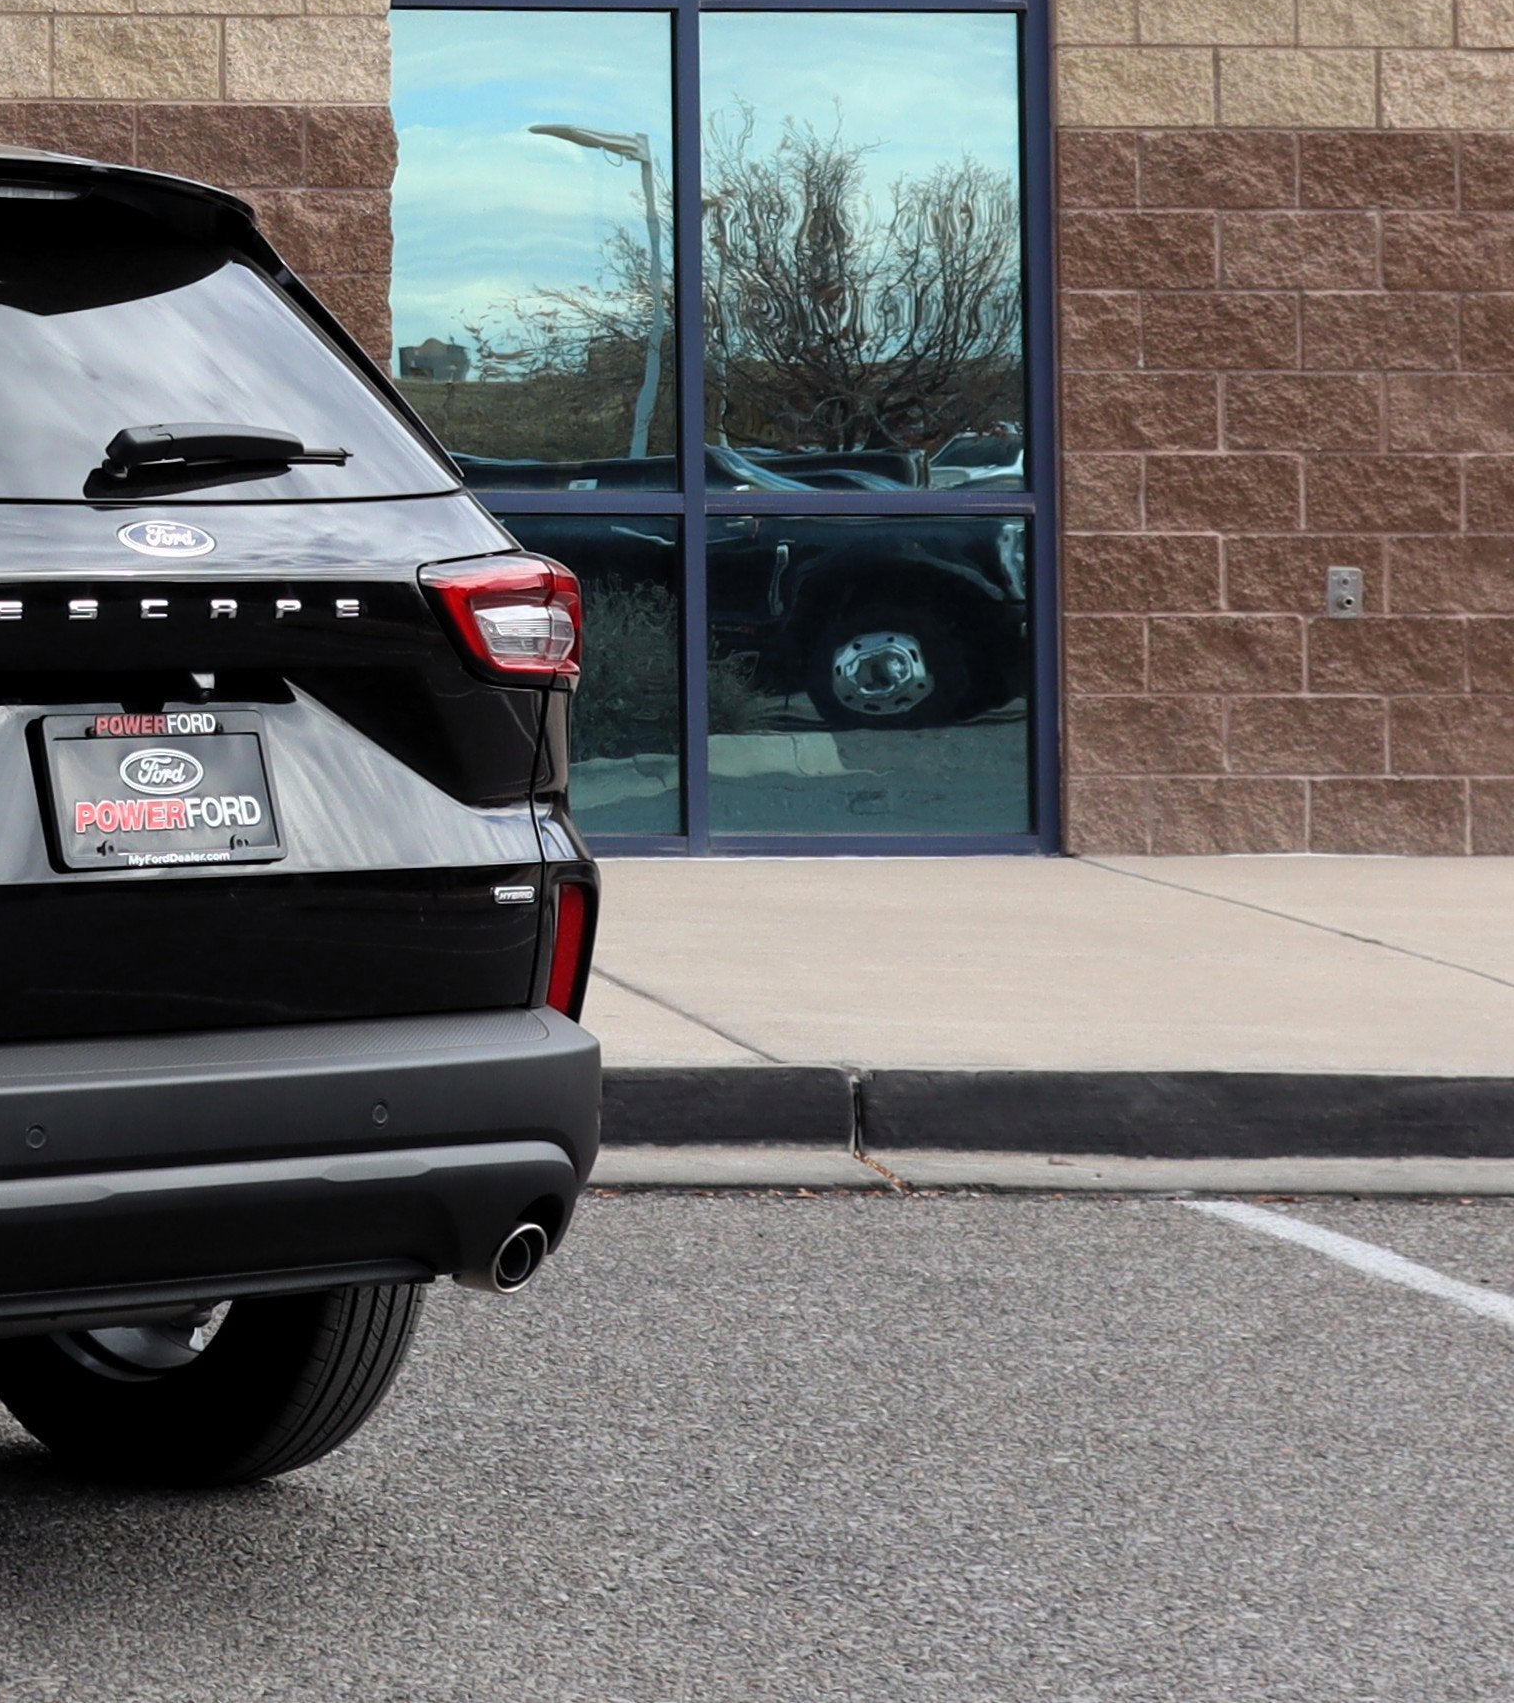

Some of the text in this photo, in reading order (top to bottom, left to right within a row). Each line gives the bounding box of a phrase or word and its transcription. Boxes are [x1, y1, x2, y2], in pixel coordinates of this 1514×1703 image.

[144, 525, 197, 547] Ford
[94, 713, 217, 736] POWERFORD
[137, 757, 186, 784] Ford
[75, 796, 262, 834] POWERFORD
[128, 852, 231, 867] MyFordDealer.com
